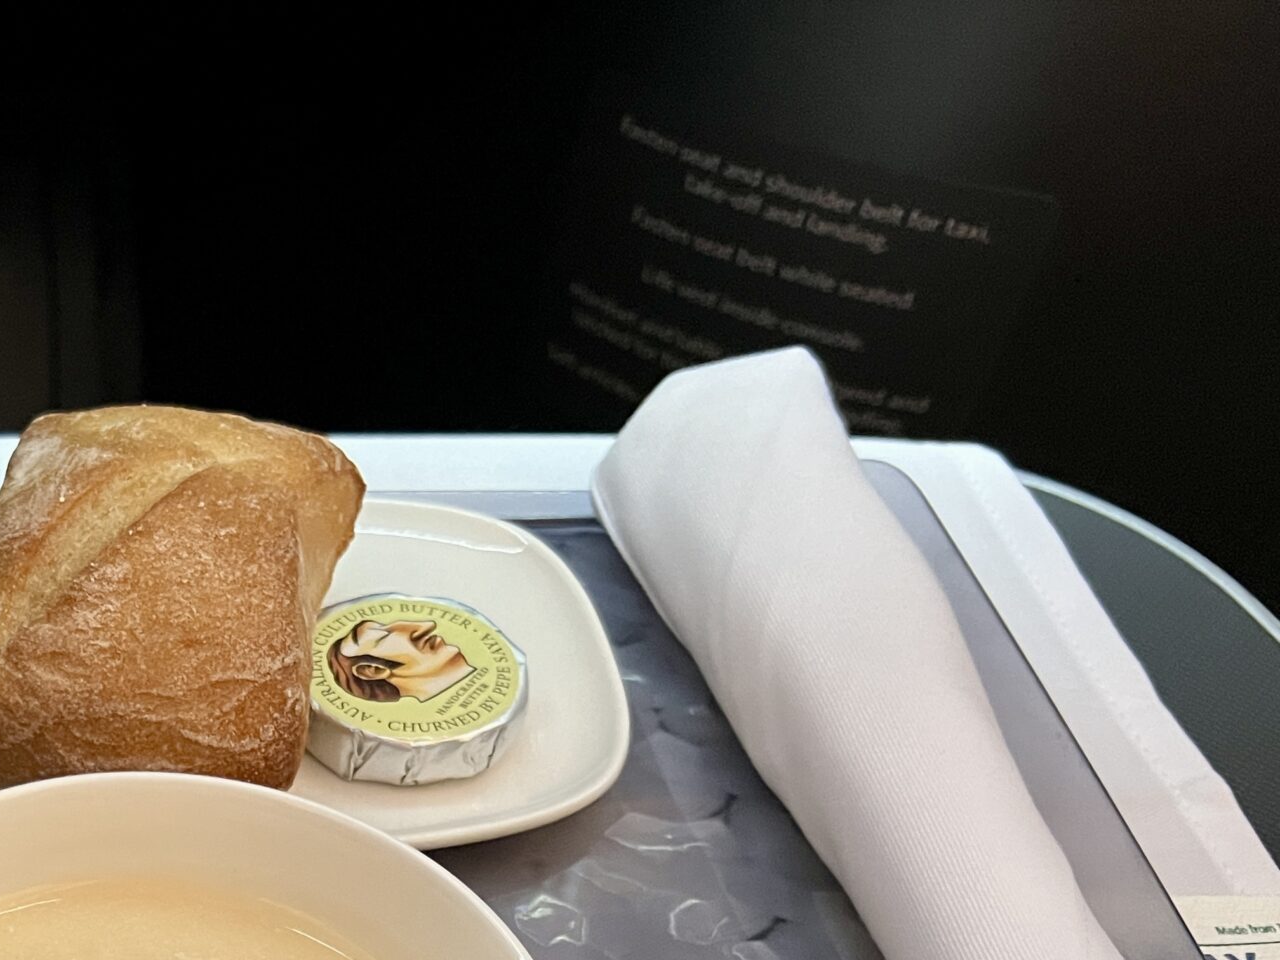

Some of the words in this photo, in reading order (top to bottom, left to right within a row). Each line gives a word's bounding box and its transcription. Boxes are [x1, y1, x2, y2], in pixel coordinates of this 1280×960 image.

[859, 198, 904, 226] belt
[906, 207, 941, 232] for
[314, 602, 393, 646] CULTURED
[399, 602, 472, 631] BUTTER
[481, 632, 510, 664] SAYA
[312, 648, 373, 723] AUSTRALIAN
[435, 666, 490, 717] HANDCRAFTED
[461, 682, 490, 710] BUTTER
[495, 666, 512, 698] PEPE
[387, 709, 481, 734] CHURNED
[483, 696, 502, 715] BY
[1214, 925, 1249, 936] Made
[1248, 923, 1277, 934] from
